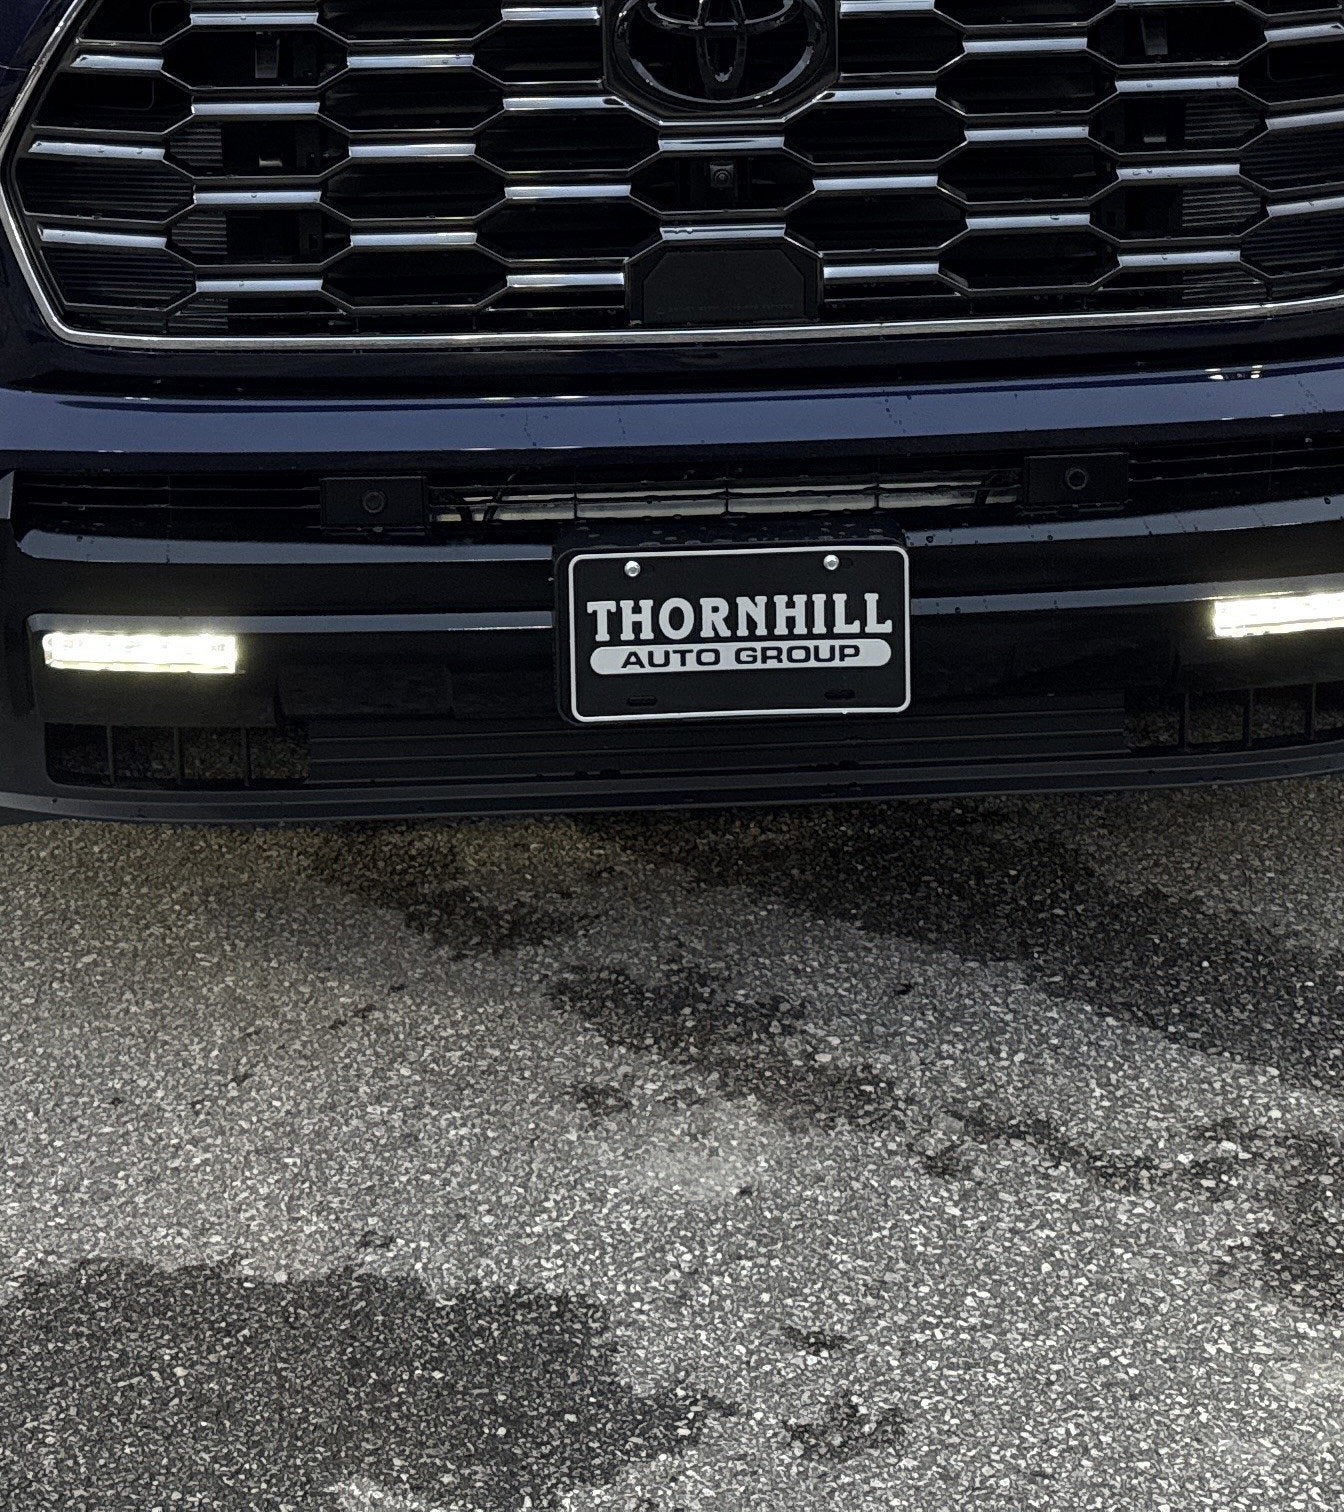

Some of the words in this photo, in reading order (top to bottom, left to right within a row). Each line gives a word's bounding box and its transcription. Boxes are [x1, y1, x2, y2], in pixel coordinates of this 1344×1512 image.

[586, 592, 892, 642] THORNHILL
[621, 647, 721, 669] AUTO
[734, 643, 861, 665] GROUP
